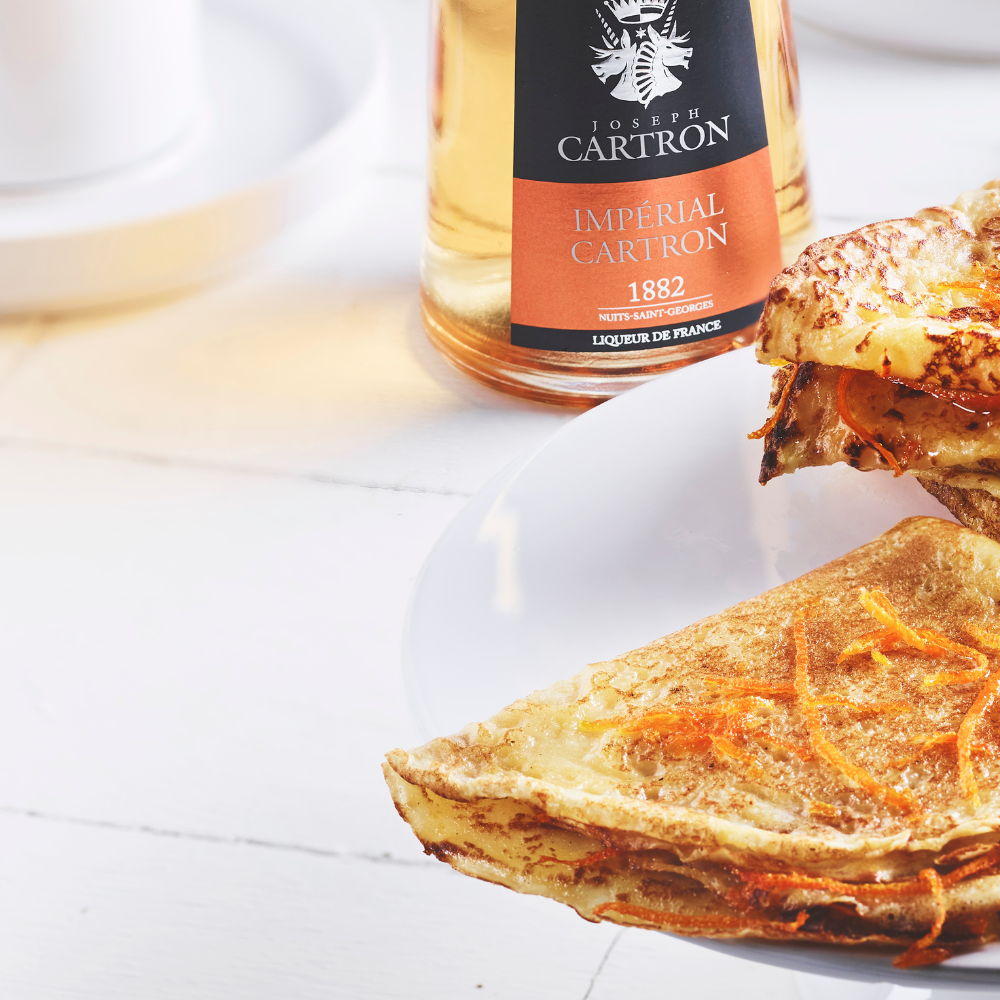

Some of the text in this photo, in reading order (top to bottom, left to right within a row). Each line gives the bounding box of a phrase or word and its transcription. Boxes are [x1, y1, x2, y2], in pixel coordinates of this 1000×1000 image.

[557, 115, 731, 162] CARTRON
[573, 192, 725, 232] IMPÉRIAL
[571, 222, 728, 264] CARTRON
[628, 275, 686, 303] 1882
[598, 299, 714, 322] NUITS-SAINT-GEORGES
[592, 319, 722, 347] LIQUEUR DE FRANCE
